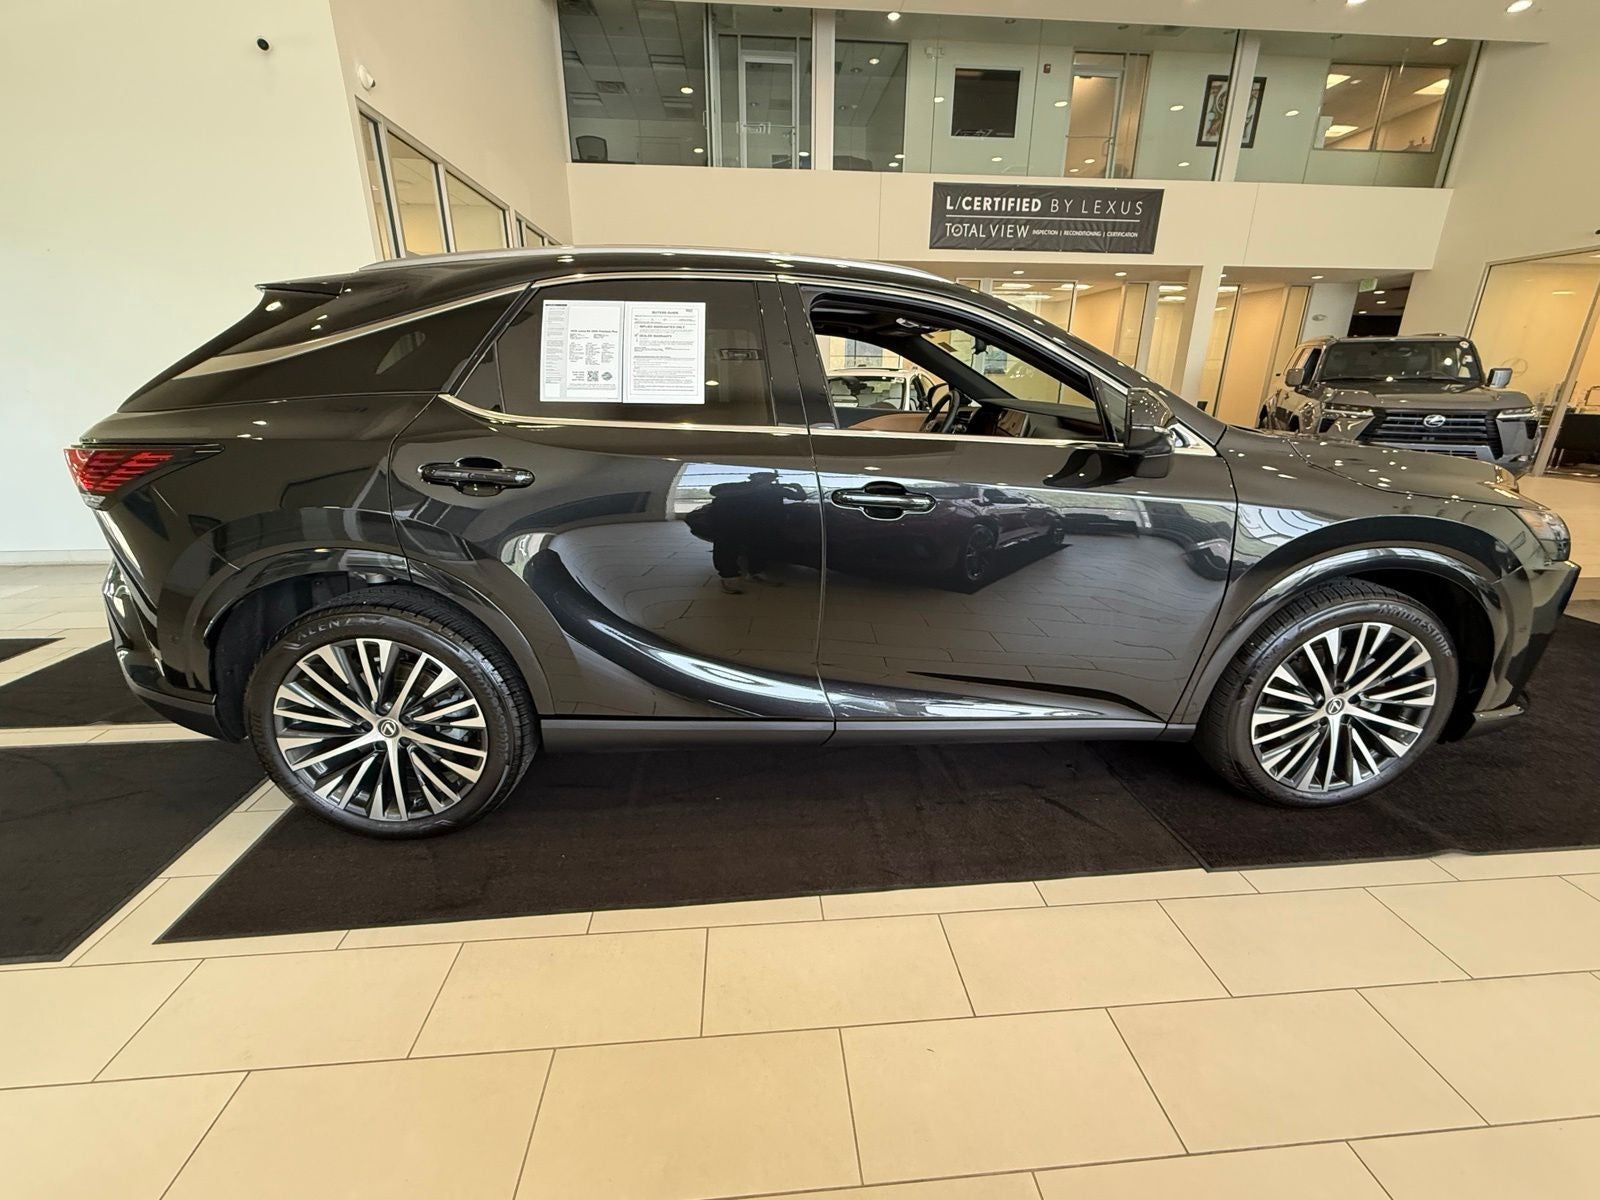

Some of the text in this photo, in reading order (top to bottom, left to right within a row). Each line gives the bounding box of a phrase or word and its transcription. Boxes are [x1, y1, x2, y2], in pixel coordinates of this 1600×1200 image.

[946, 196, 1143, 215] L/CERTIFIED BY LEXUS
[945, 223, 986, 238] TOTAL
[990, 224, 1030, 238] VIEW
